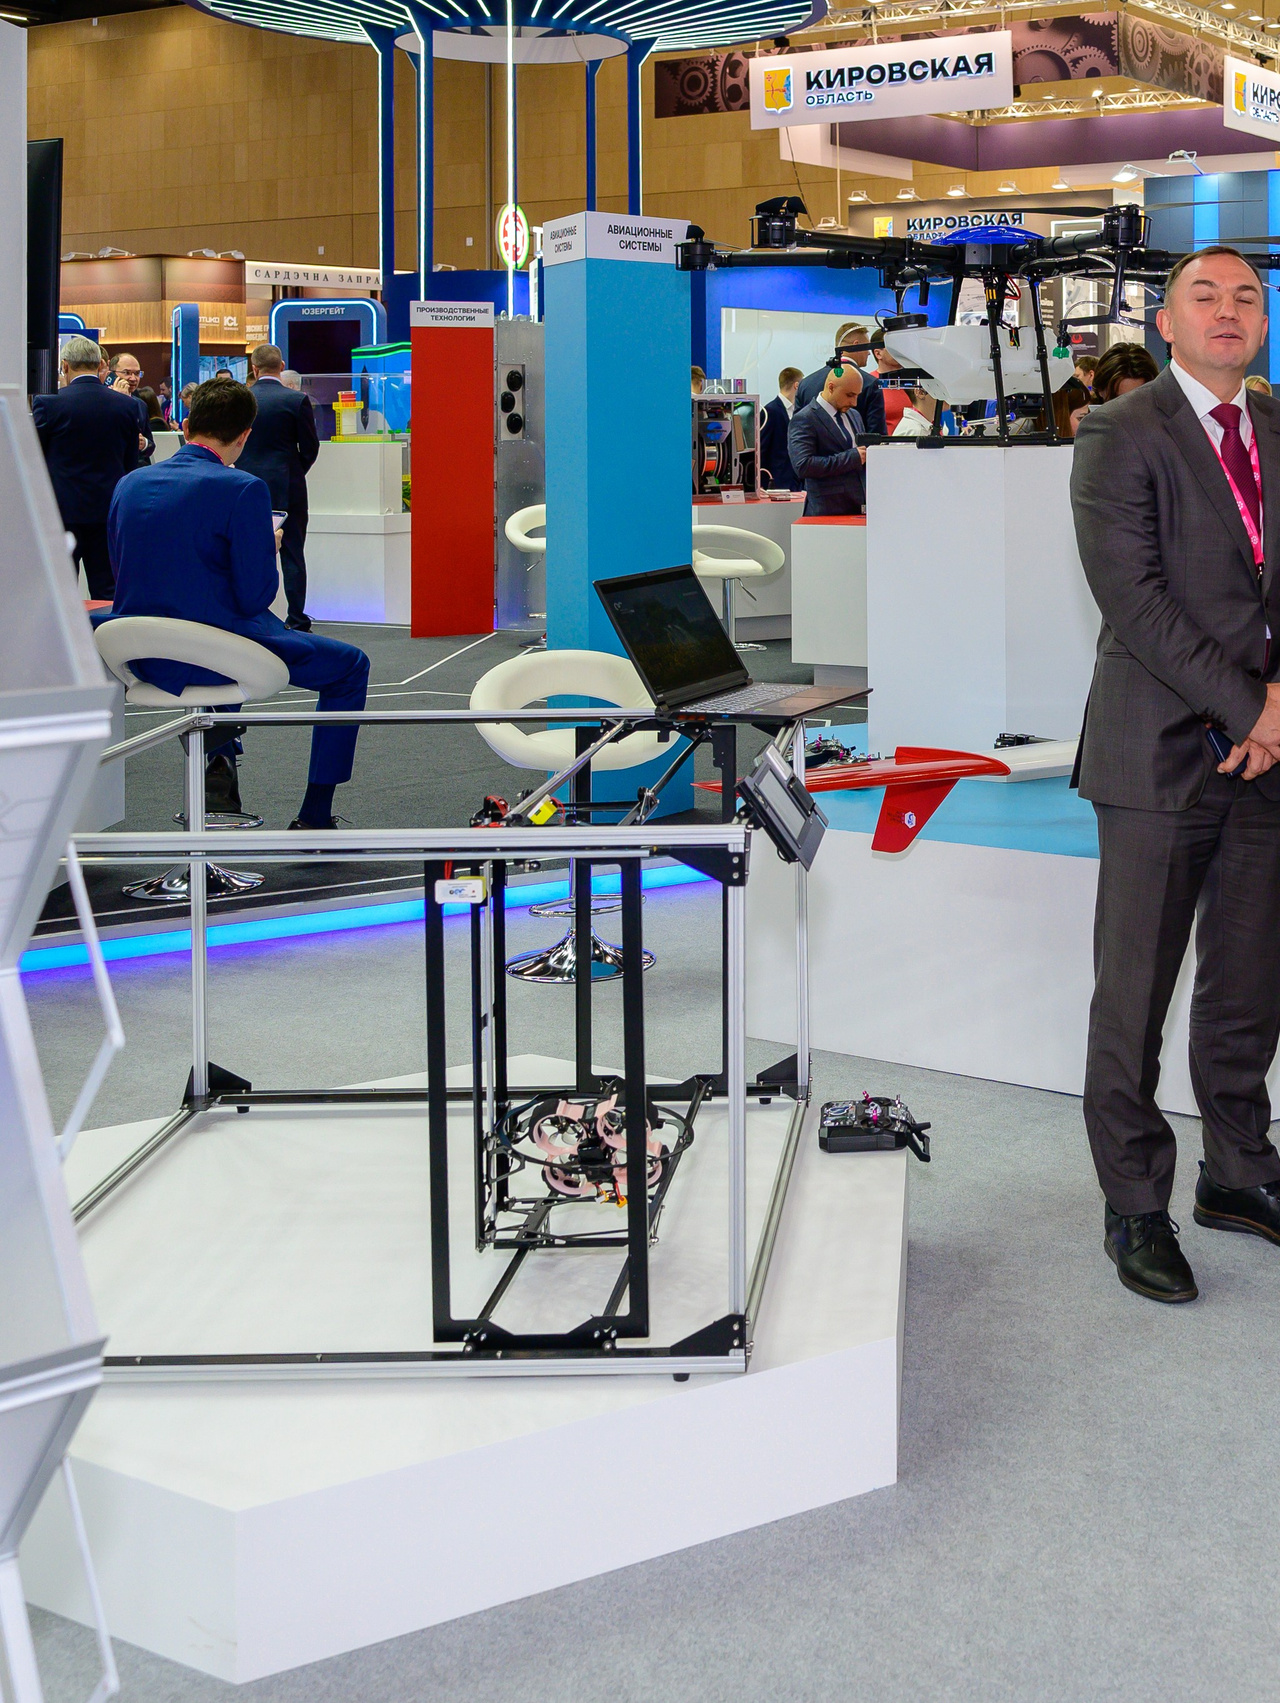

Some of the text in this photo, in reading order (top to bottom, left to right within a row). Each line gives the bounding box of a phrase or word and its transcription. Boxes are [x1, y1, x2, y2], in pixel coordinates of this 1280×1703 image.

[806, 52, 994, 91] КИРОВСКАЯ
[805, 90, 873, 106] ОБЛАСТЬ
[906, 212, 1024, 231] КИРОВСКАЯ
[550, 225, 577, 240] АВИАЦИОННЫЕ
[607, 224, 673, 240] АВИАЦИОННЫЕ
[554, 241, 573, 253] СИСТЕМЫ
[619, 239, 662, 252] СИСТЕМЫ
[254, 269, 329, 282] САРДЭЧНА
[301, 307, 346, 316] ЮЗЕРГЕЙТ
[416, 306, 489, 315] ПРОИЗВОДСТВЕННЫЕ
[431, 314, 476, 322] ТЕХНОЛОГИИ
